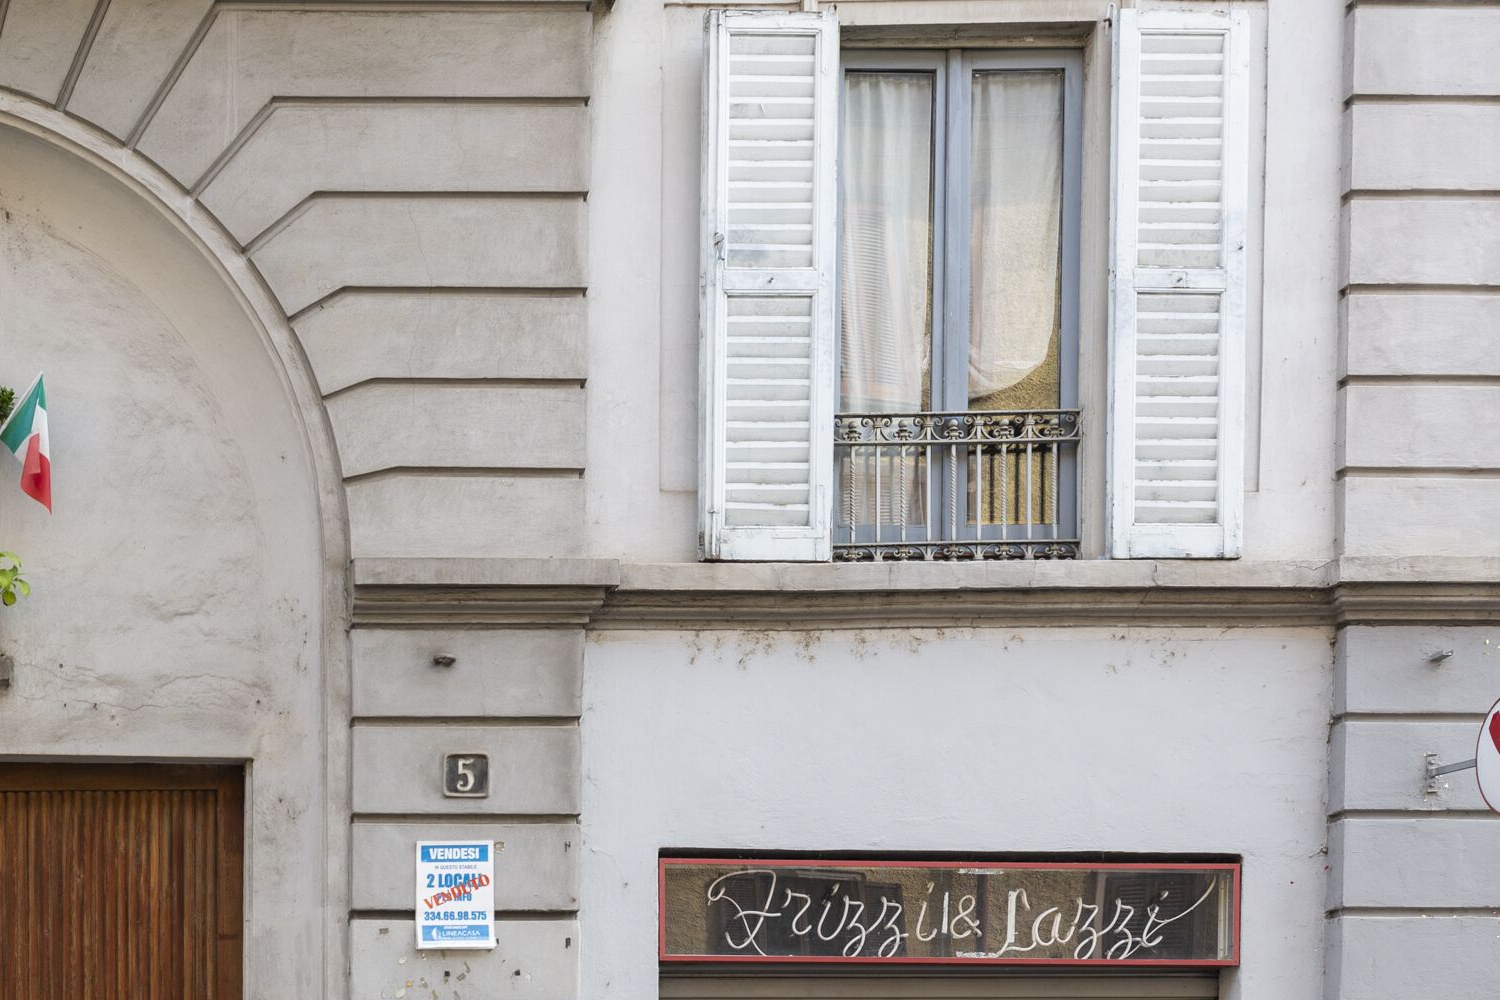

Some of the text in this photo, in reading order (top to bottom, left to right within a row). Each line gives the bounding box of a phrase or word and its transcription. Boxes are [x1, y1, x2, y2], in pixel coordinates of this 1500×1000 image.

[456, 758, 475, 791] 5
[429, 847, 479, 860] VENDESI
[423, 874, 490, 909] VENDUTO
[426, 873, 435, 888] 2
[424, 910, 487, 921] 334.66.98.575
[708, 869, 1216, 960] Frizzi & Lazzi
